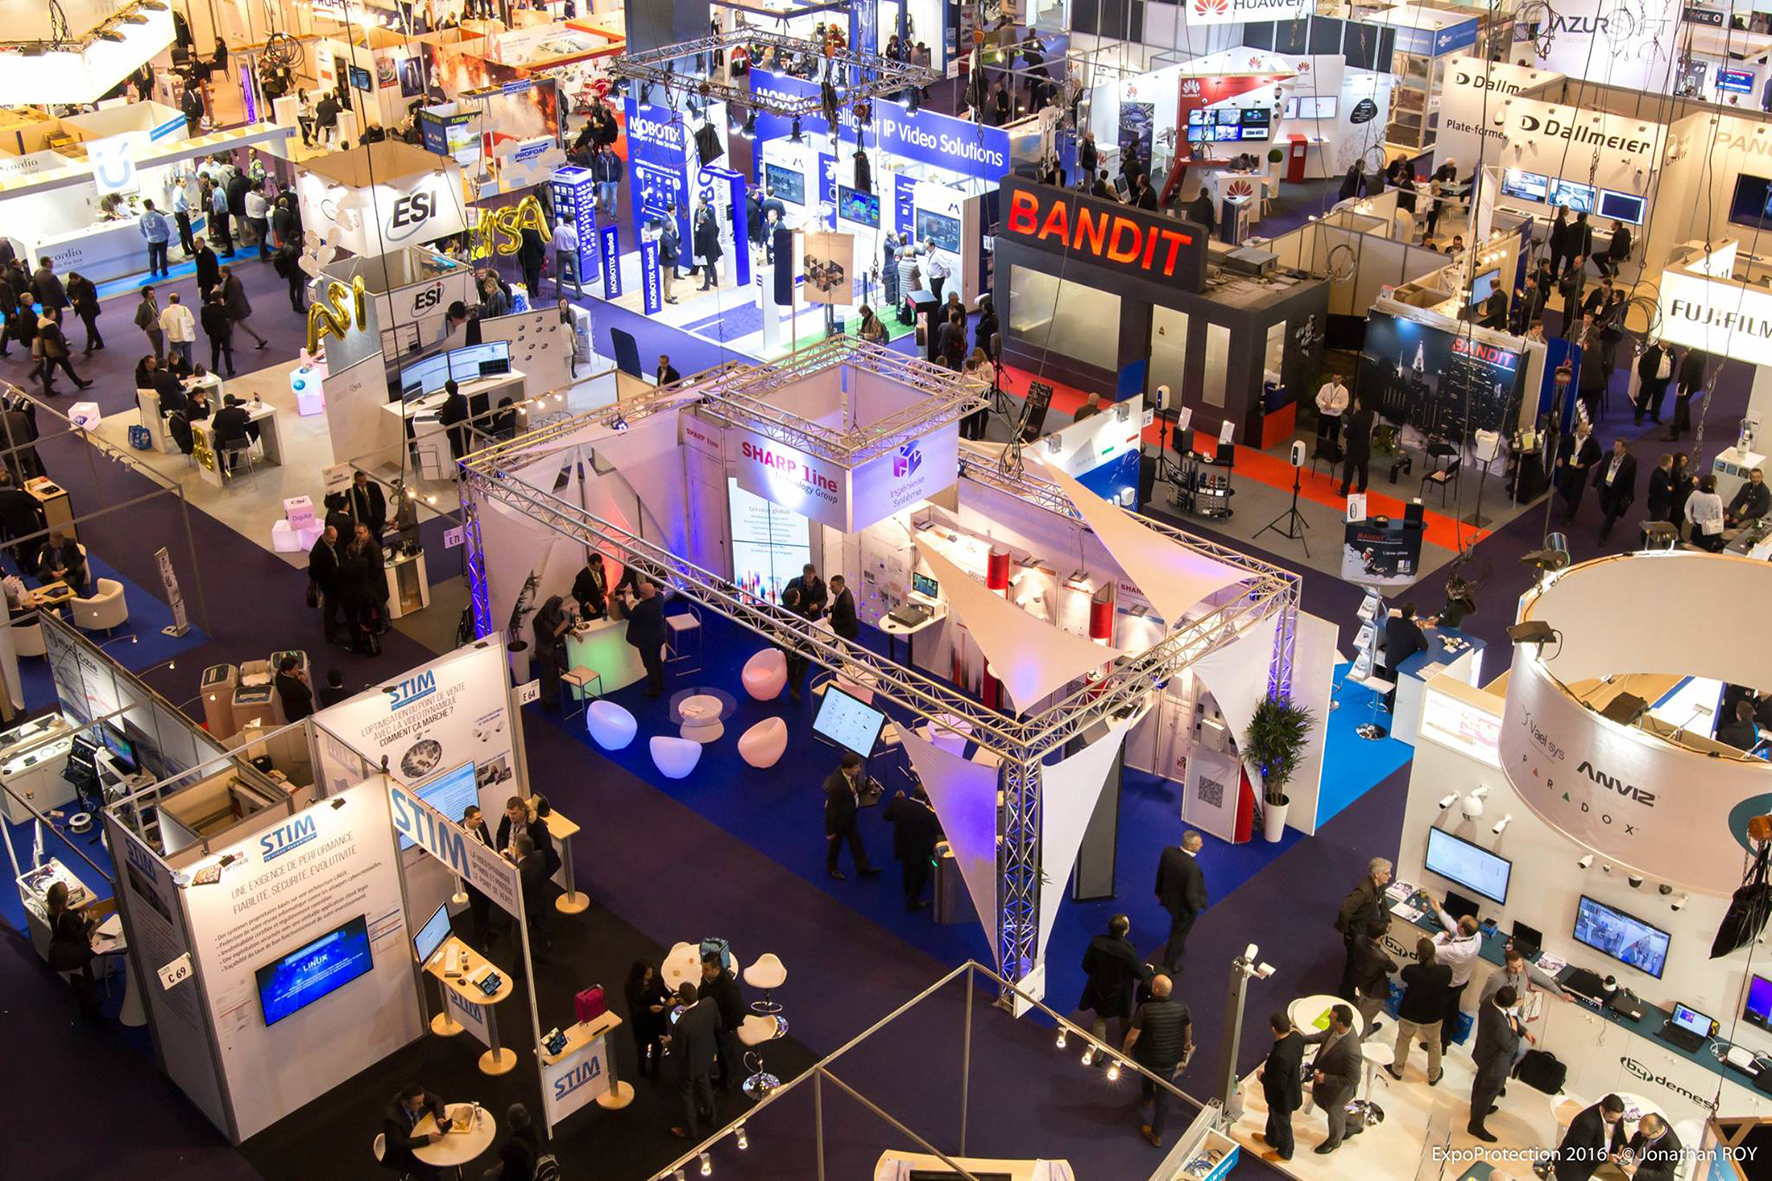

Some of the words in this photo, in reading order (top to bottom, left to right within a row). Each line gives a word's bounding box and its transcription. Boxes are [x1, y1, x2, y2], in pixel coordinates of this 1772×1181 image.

[630, 116, 680, 142] MOBOTIX
[883, 118, 896, 139] IP
[898, 122, 938, 150] Video
[940, 132, 1003, 168] Solutions
[1544, 119, 1652, 156] Dallmeier
[1715, 131, 1772, 158] PAN
[392, 190, 436, 228] ESI
[1008, 188, 1192, 277] BANDIT
[1452, 338, 1515, 368] BANDIT
[686, 428, 706, 442] SHARP
[706, 436, 720, 449] line
[741, 441, 798, 474] SHARP
[802, 464, 838, 493] line
[815, 488, 838, 506] Group
[890, 476, 925, 499] Ingénierie
[892, 488, 922, 508] Système
[388, 670, 436, 704] STIM
[446, 682, 466, 697] VENTE
[528, 689, 536, 700] 64
[380, 727, 412, 748] COMMENT
[422, 711, 448, 727] MARCHE
[1576, 761, 1656, 808] ANVIZ
[260, 814, 317, 856] STIM
[392, 788, 471, 880] STIM
[125, 837, 158, 884] STIM
[232, 884, 248, 900] UNE
[248, 864, 285, 891] EXIGENCE
[286, 858, 298, 873] DE
[298, 831, 354, 866] PERFORMANCE
[168, 973, 176, 984] C
[176, 966, 188, 981] 69
[302, 954, 328, 972] LINUX
[554, 1055, 600, 1097] STIM
[1655, 1076, 1714, 1110] demes
